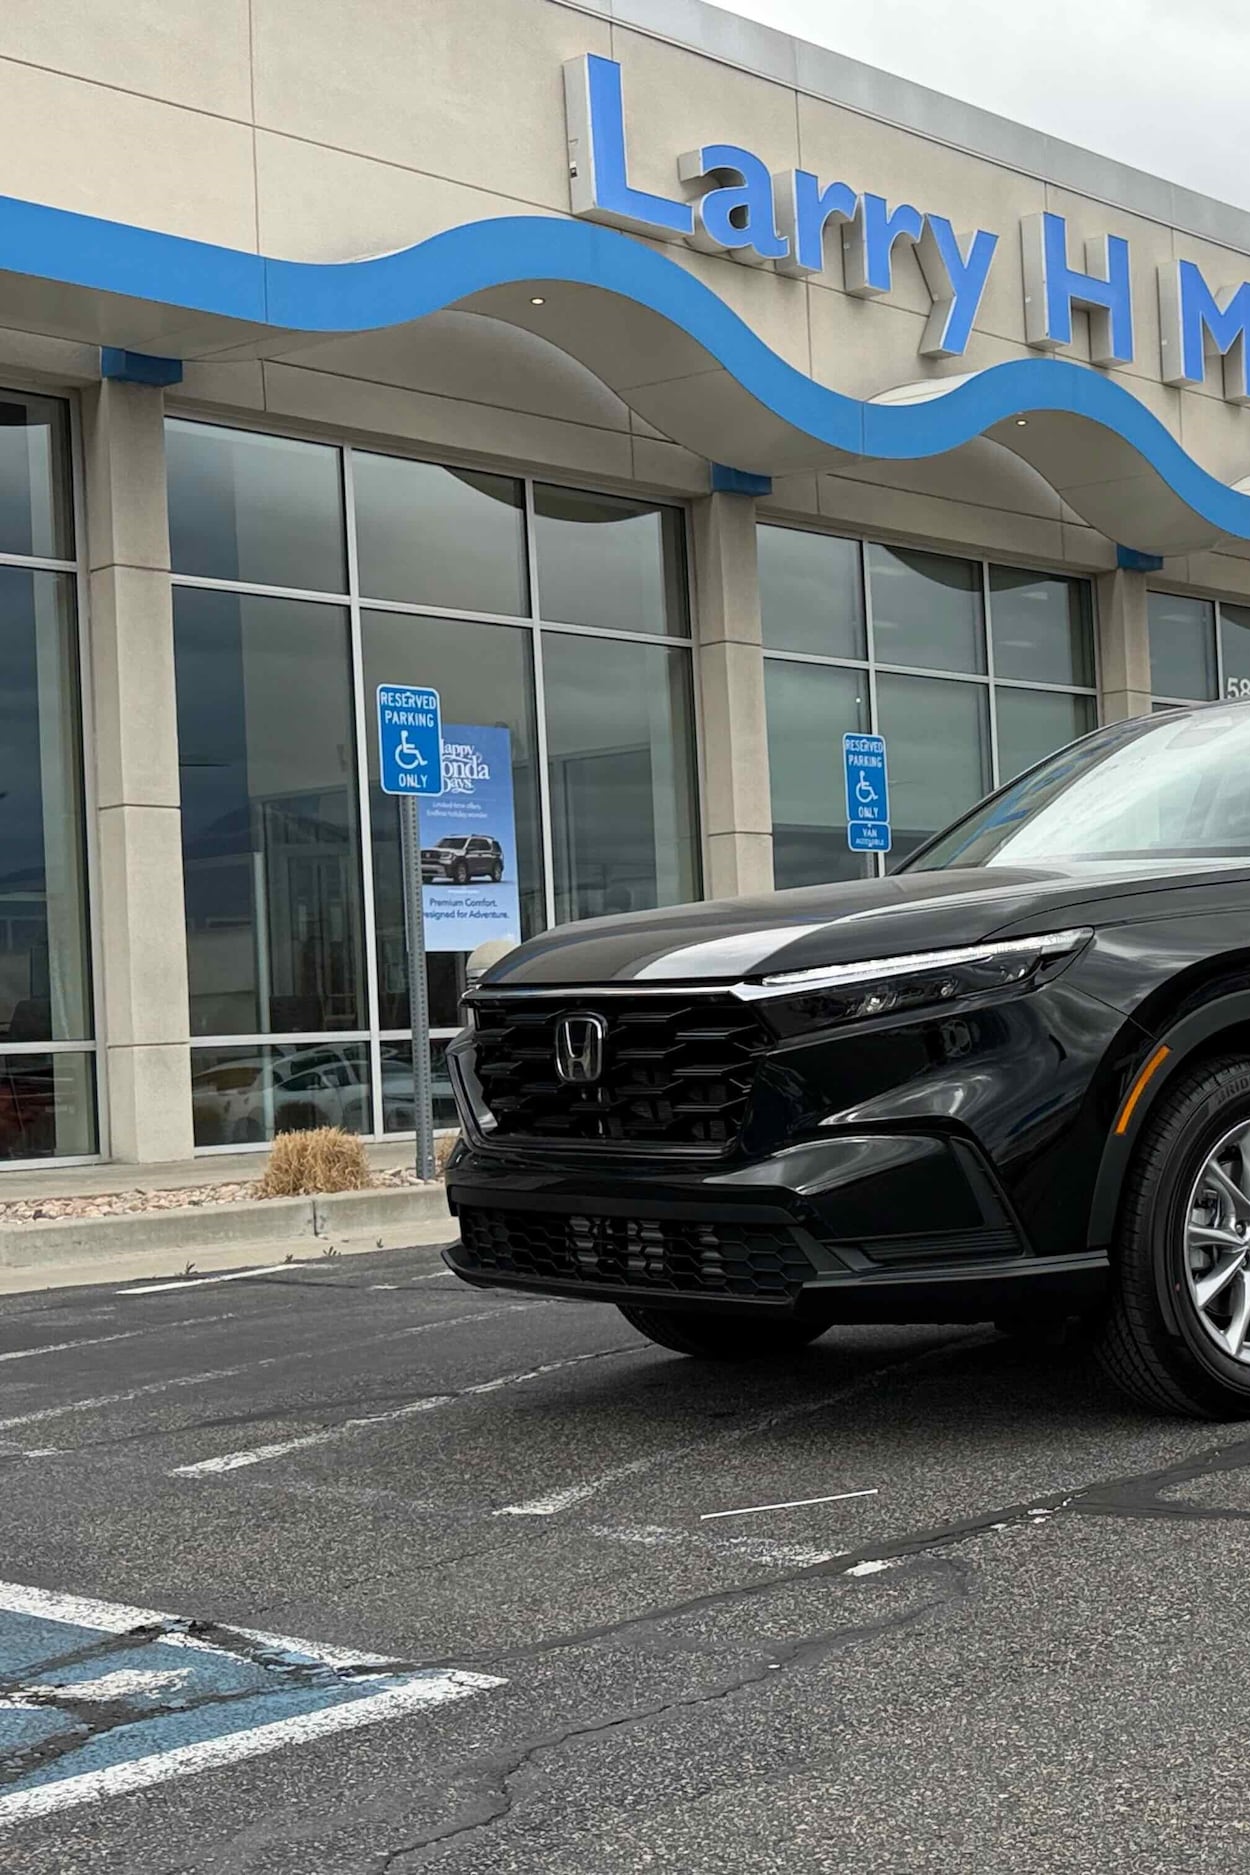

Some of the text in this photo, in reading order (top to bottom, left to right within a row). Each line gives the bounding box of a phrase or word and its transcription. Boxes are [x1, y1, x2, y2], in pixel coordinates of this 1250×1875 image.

[572, 53, 999, 358] Larry
[1034, 211, 1134, 367] H
[380, 691, 437, 710] RESERVED
[384, 710, 435, 728] PARKING
[846, 739, 882, 753] RESERVED
[441, 756, 490, 780] onda
[848, 754, 882, 768] PARKING
[398, 773, 428, 788] ONLY
[858, 806, 879, 819] ONLY
[862, 828, 878, 838] VAN
[429, 898, 498, 907] Premium Comfort.
[423, 910, 510, 920] esigned for Adventure.
